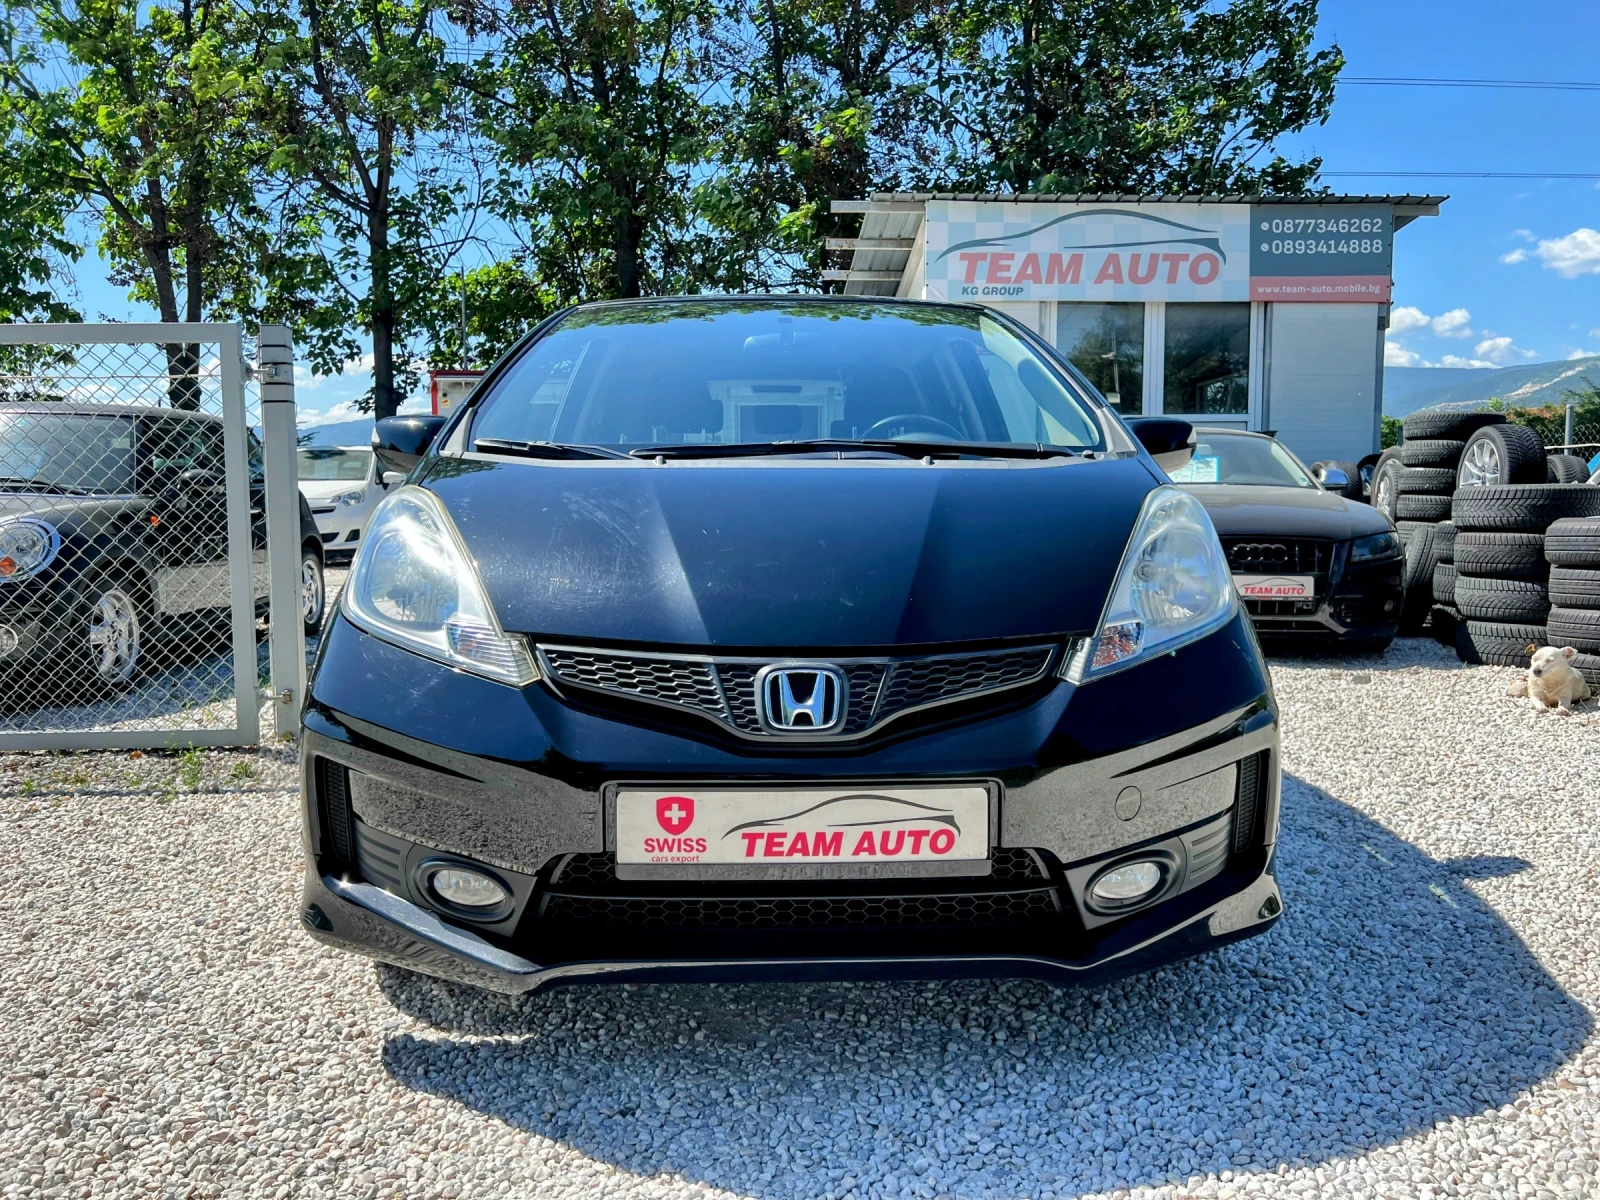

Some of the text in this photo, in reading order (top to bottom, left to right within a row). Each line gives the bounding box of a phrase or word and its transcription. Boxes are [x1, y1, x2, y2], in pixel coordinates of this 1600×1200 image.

[1272, 218, 1383, 234] 0877346262
[1272, 239, 1383, 254] 0893414888
[959, 252, 1220, 285] TEAM AUTO
[961, 286, 1024, 296] KG GROUP
[1256, 283, 1381, 294] www.team-auto.mobile.bg
[1244, 587, 1304, 595] TEAM AUTO
[644, 837, 707, 853] SWISS
[741, 828, 956, 857] TEAM AUTO
[651, 855, 700, 864] cars export
